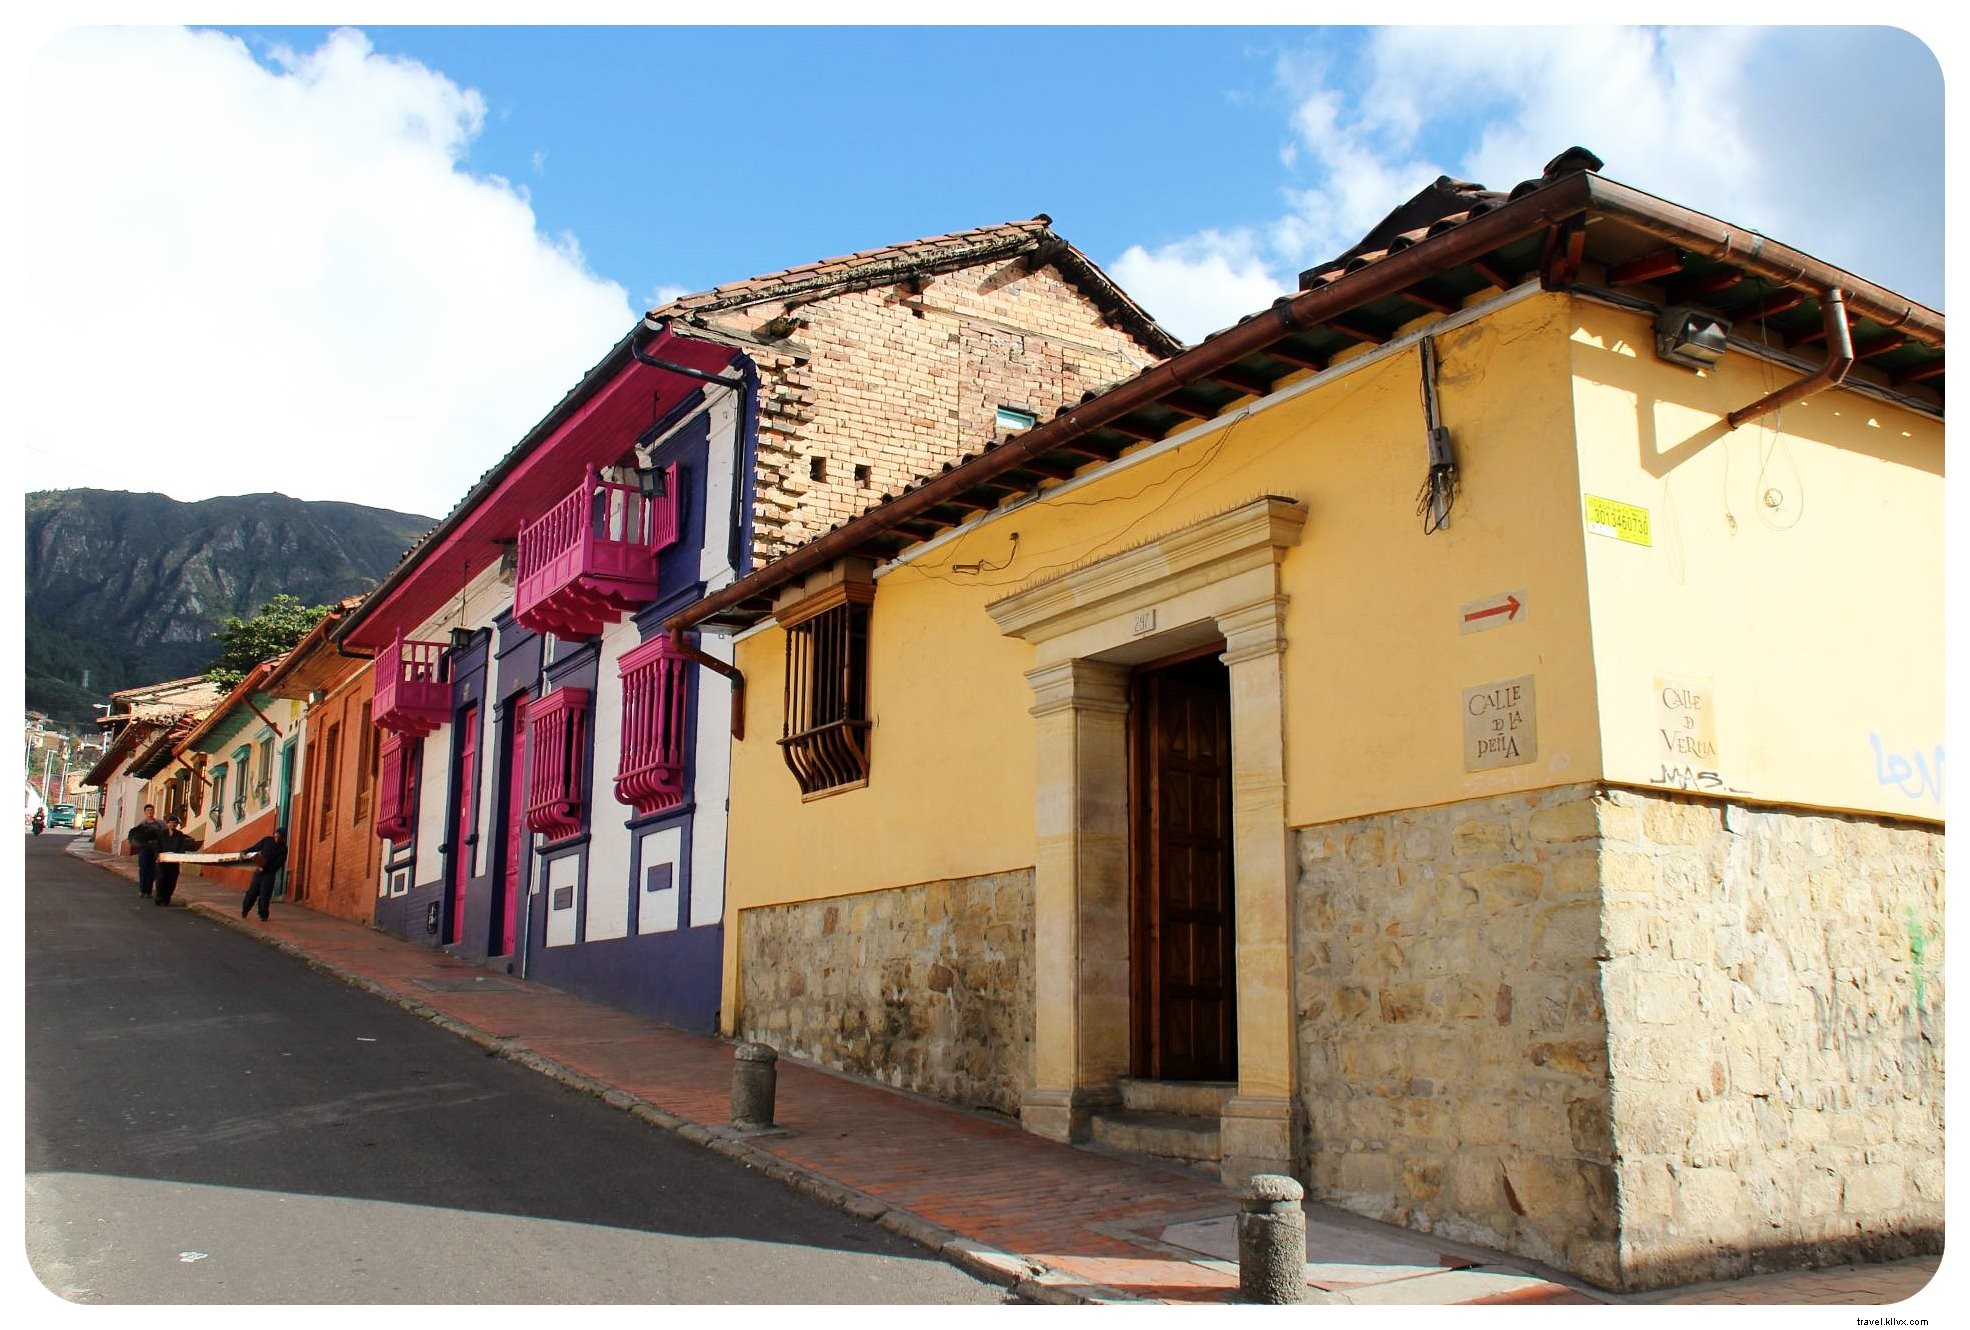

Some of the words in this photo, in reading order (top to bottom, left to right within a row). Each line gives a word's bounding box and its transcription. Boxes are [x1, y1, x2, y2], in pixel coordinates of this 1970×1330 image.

[1468, 685, 1521, 716] CALLE
[1662, 687, 1701, 710] CALLE
[1508, 710, 1523, 730] LA
